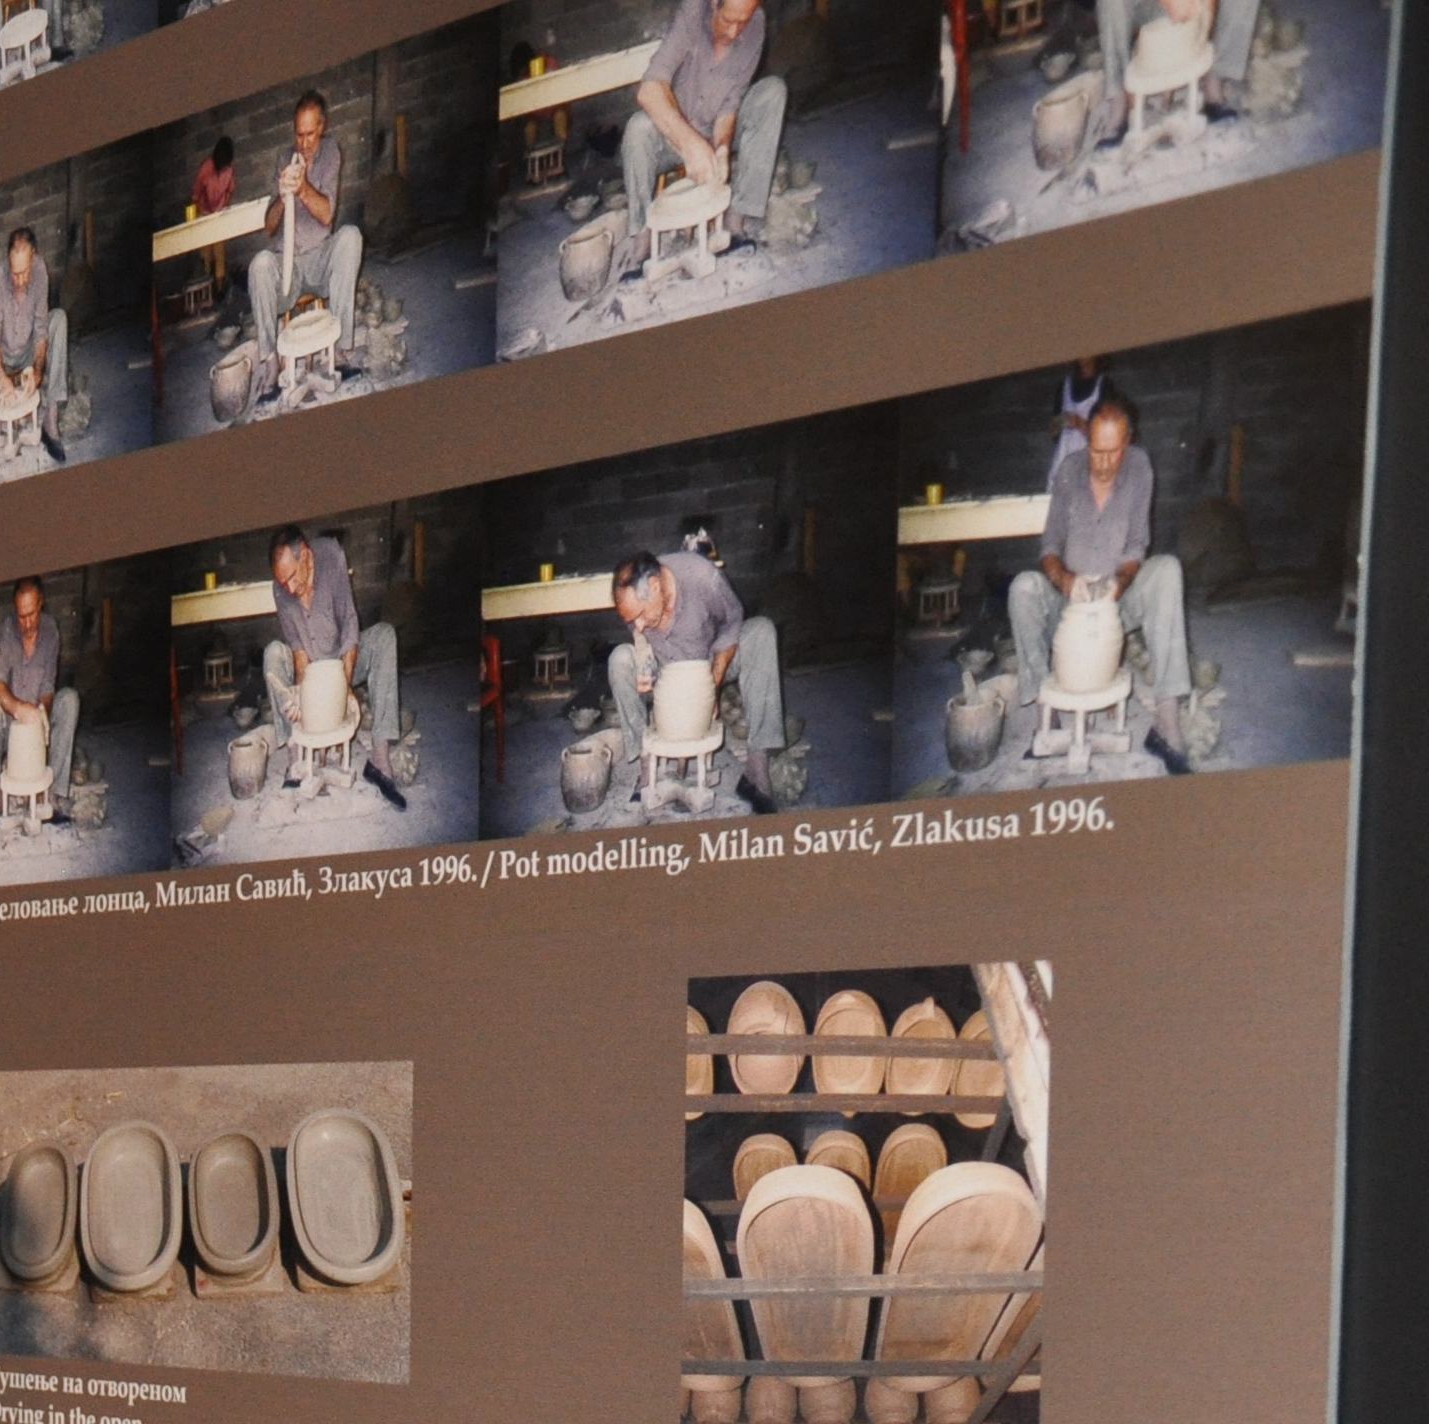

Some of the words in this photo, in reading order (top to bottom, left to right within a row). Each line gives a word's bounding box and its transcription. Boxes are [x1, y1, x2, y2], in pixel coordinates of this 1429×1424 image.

[82, 889, 151, 914] лонца,
[156, 879, 231, 908] Милан
[235, 868, 313, 901] Савић,
[318, 865, 413, 899] Злакуса
[419, 853, 478, 886] 1996.
[499, 849, 540, 879] Pot
[546, 836, 691, 876] modelling,
[698, 827, 785, 863] Milan
[793, 818, 883, 856] Savić,
[891, 808, 1021, 848] Zlakusa
[1029, 795, 1115, 836] 1996.
[62, 1375, 84, 1395] на
[87, 1377, 187, 1406] отвореном
